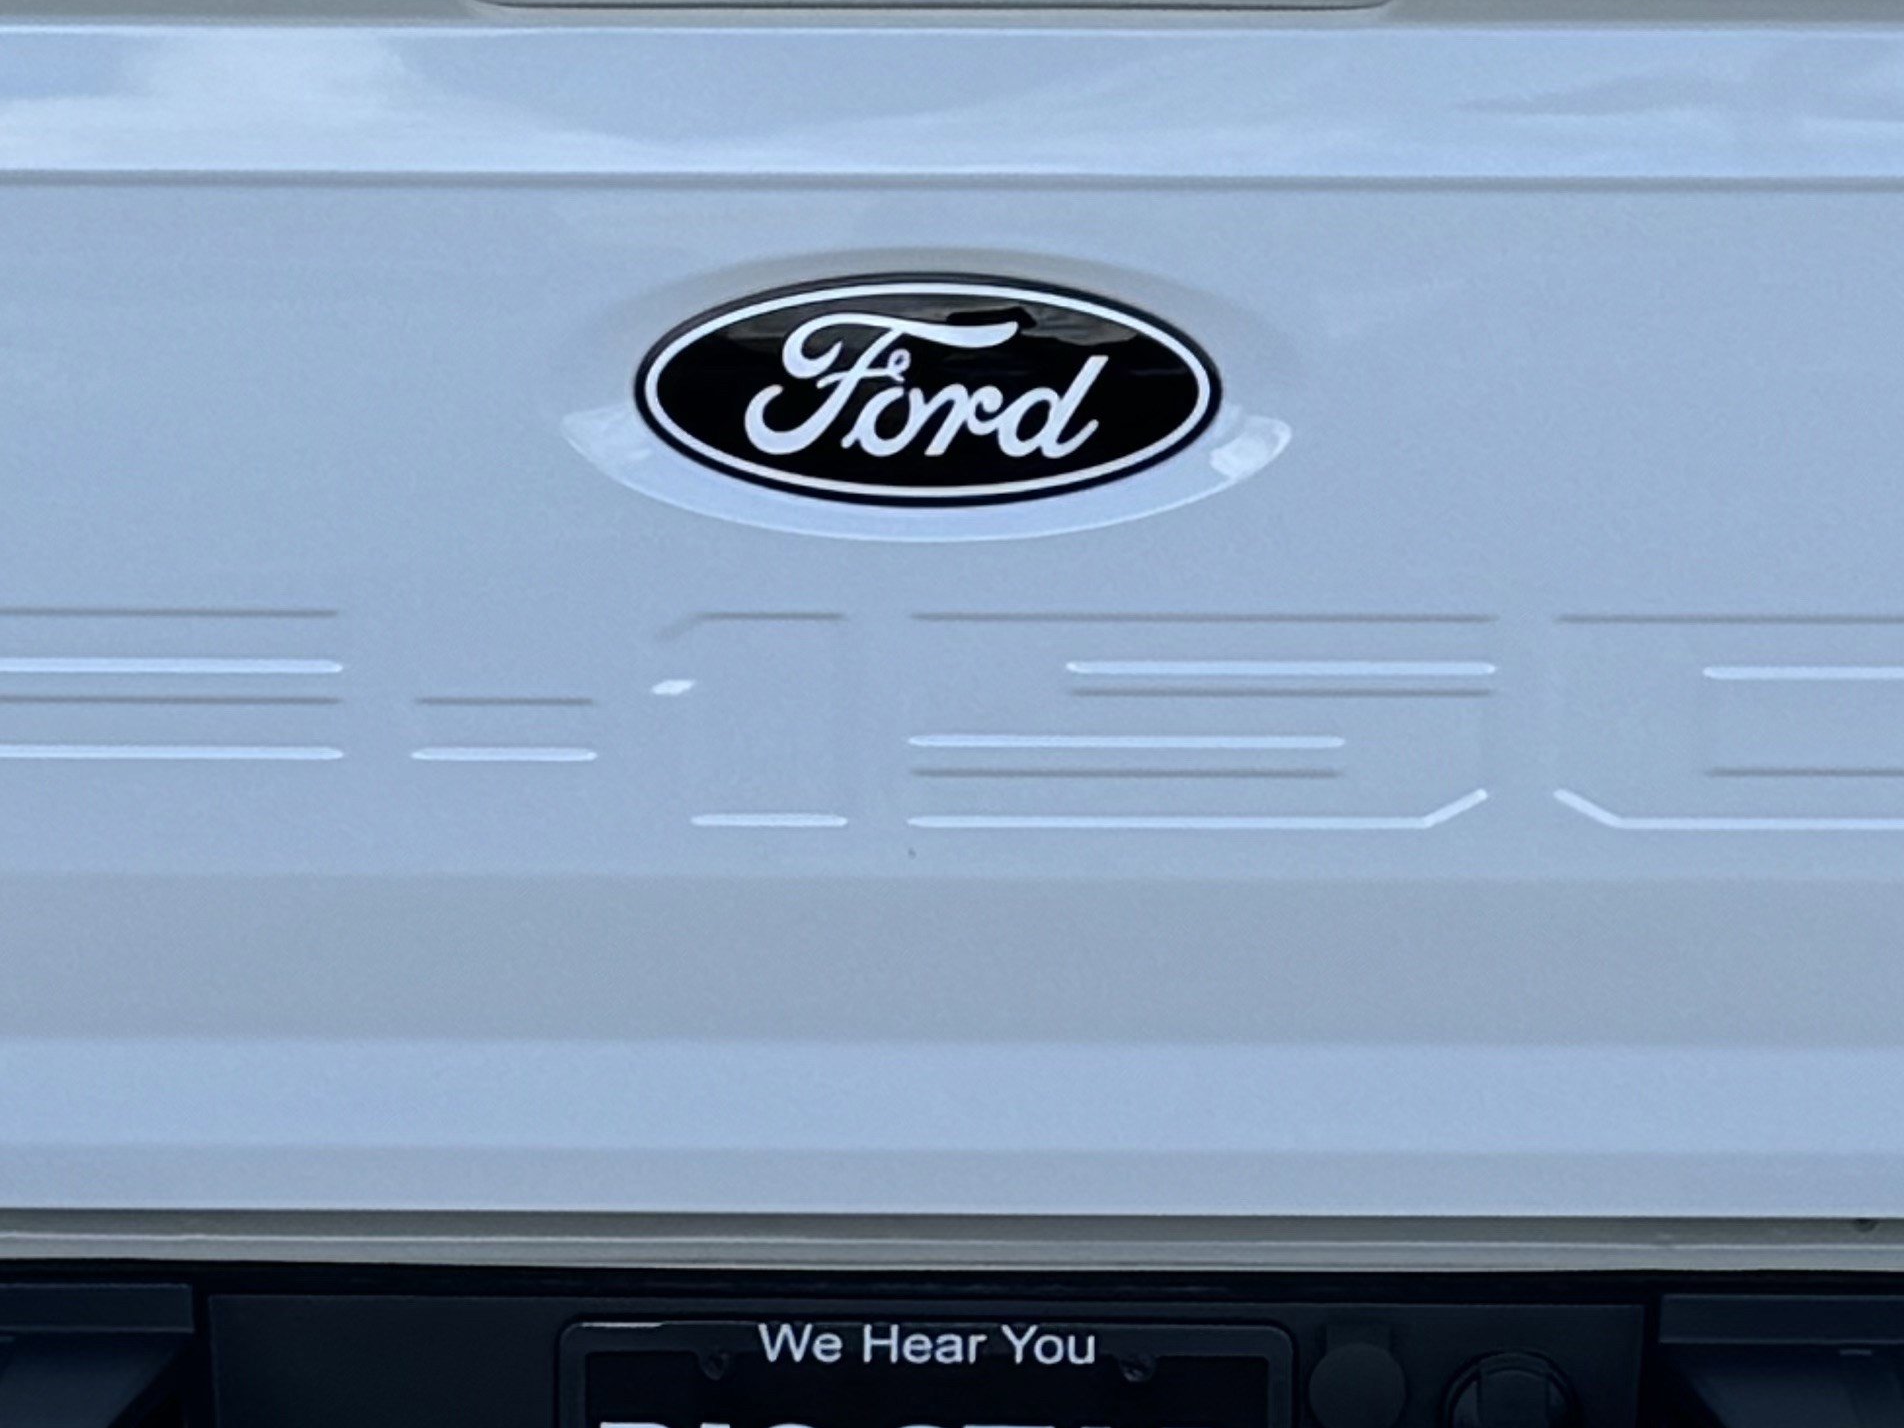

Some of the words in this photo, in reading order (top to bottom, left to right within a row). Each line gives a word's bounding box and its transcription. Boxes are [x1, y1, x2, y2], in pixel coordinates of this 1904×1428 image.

[744, 311, 1110, 459] Ford
[757, 1322, 843, 1364] We
[862, 1323, 988, 1365] Hear
[1000, 1323, 1096, 1365] You
